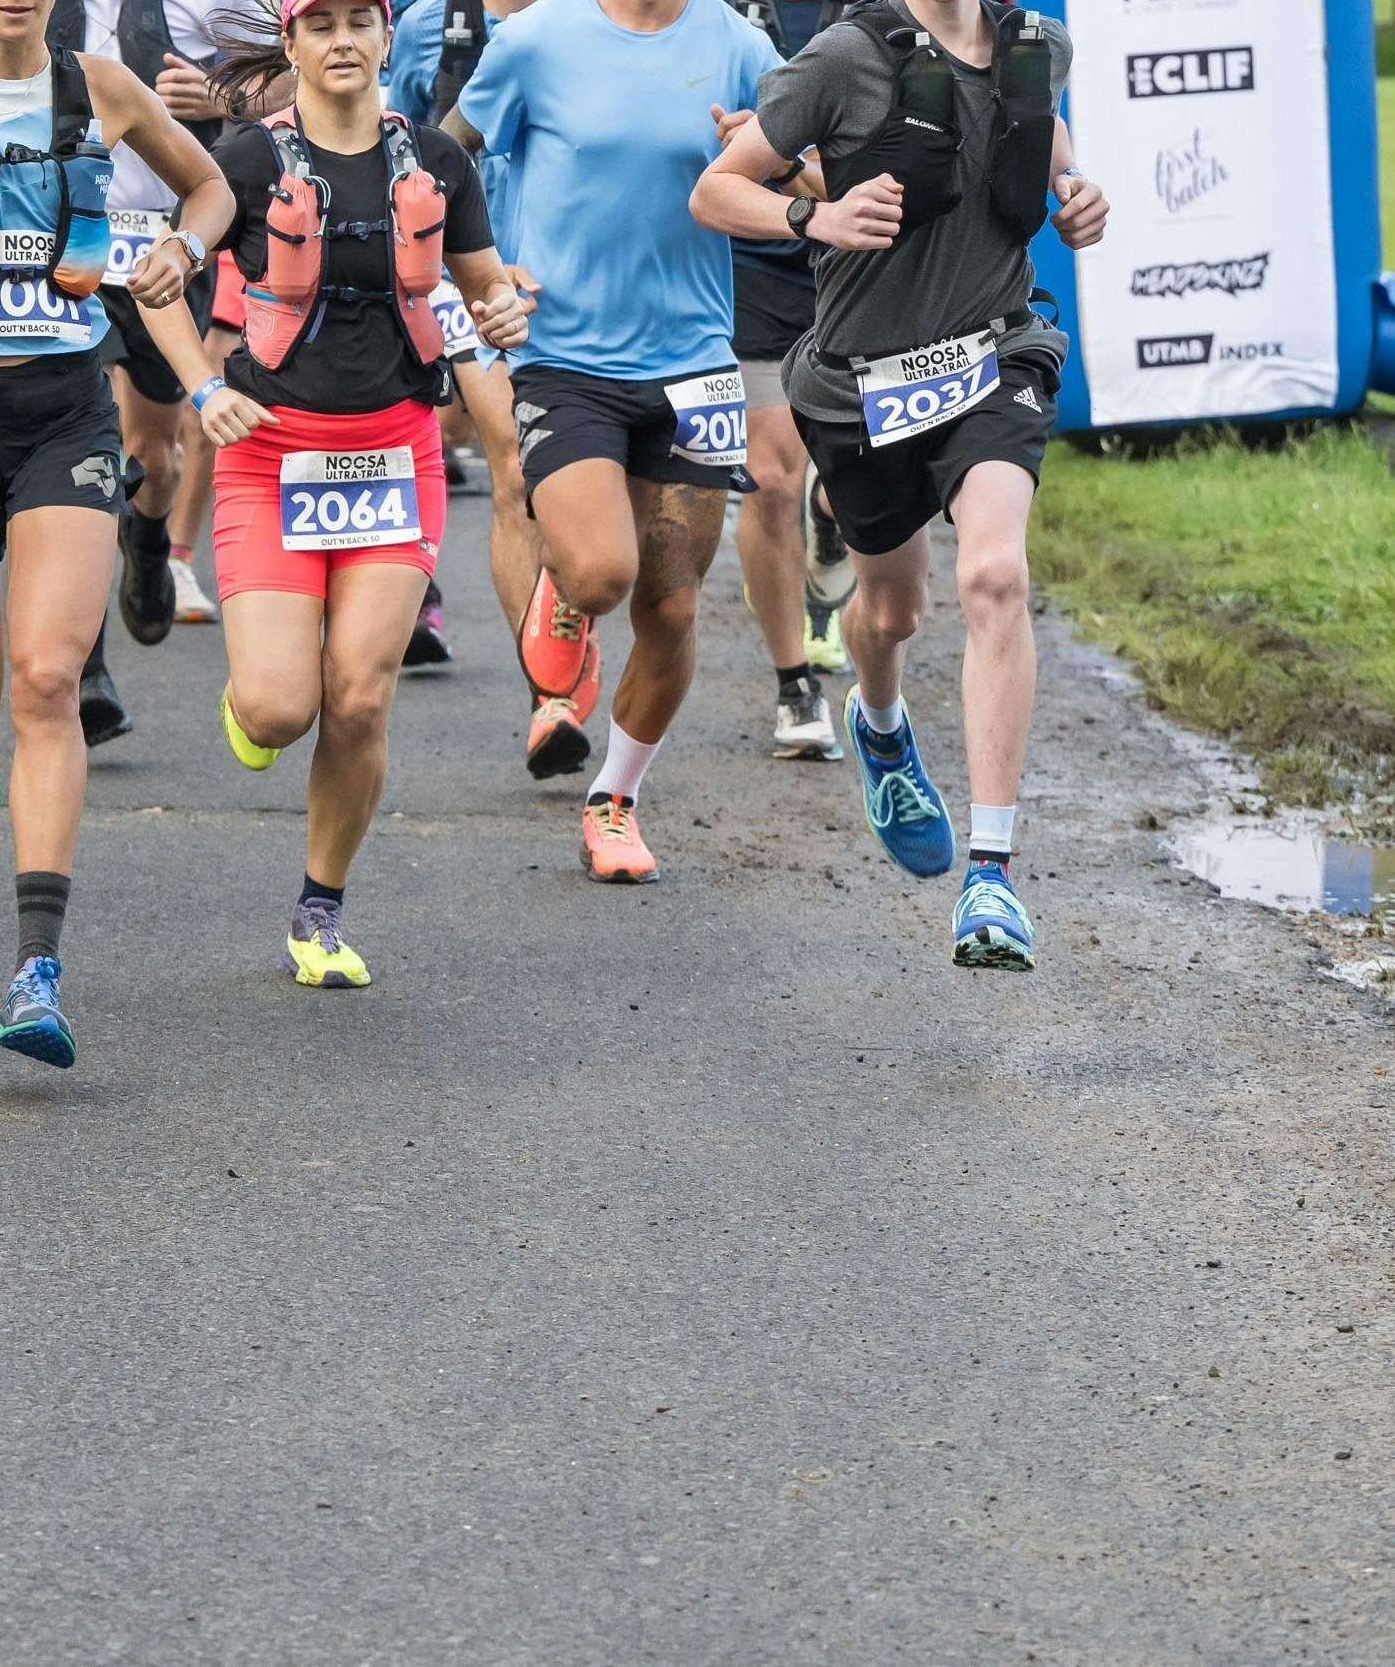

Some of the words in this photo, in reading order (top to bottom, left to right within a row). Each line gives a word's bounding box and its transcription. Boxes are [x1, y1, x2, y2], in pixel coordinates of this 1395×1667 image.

[1153, 49, 1251, 94] CLIF
[109, 212, 149, 225] OOSA
[5, 235, 54, 253] NOOS
[0, 324, 50, 333] OUT'N'BACK
[52, 325, 60, 334] 50
[901, 343, 968, 372] NOOSA
[1220, 341, 1284, 360] INDEX
[904, 357, 972, 382] ULTRA-TRAIL
[876, 362, 984, 431] 2037
[956, 404, 966, 412] 50
[325, 454, 387, 471] NOOSA
[325, 467, 388, 480] ULTRA-TRAIL
[290, 487, 408, 532] 2064
[370, 535, 380, 543] 50
